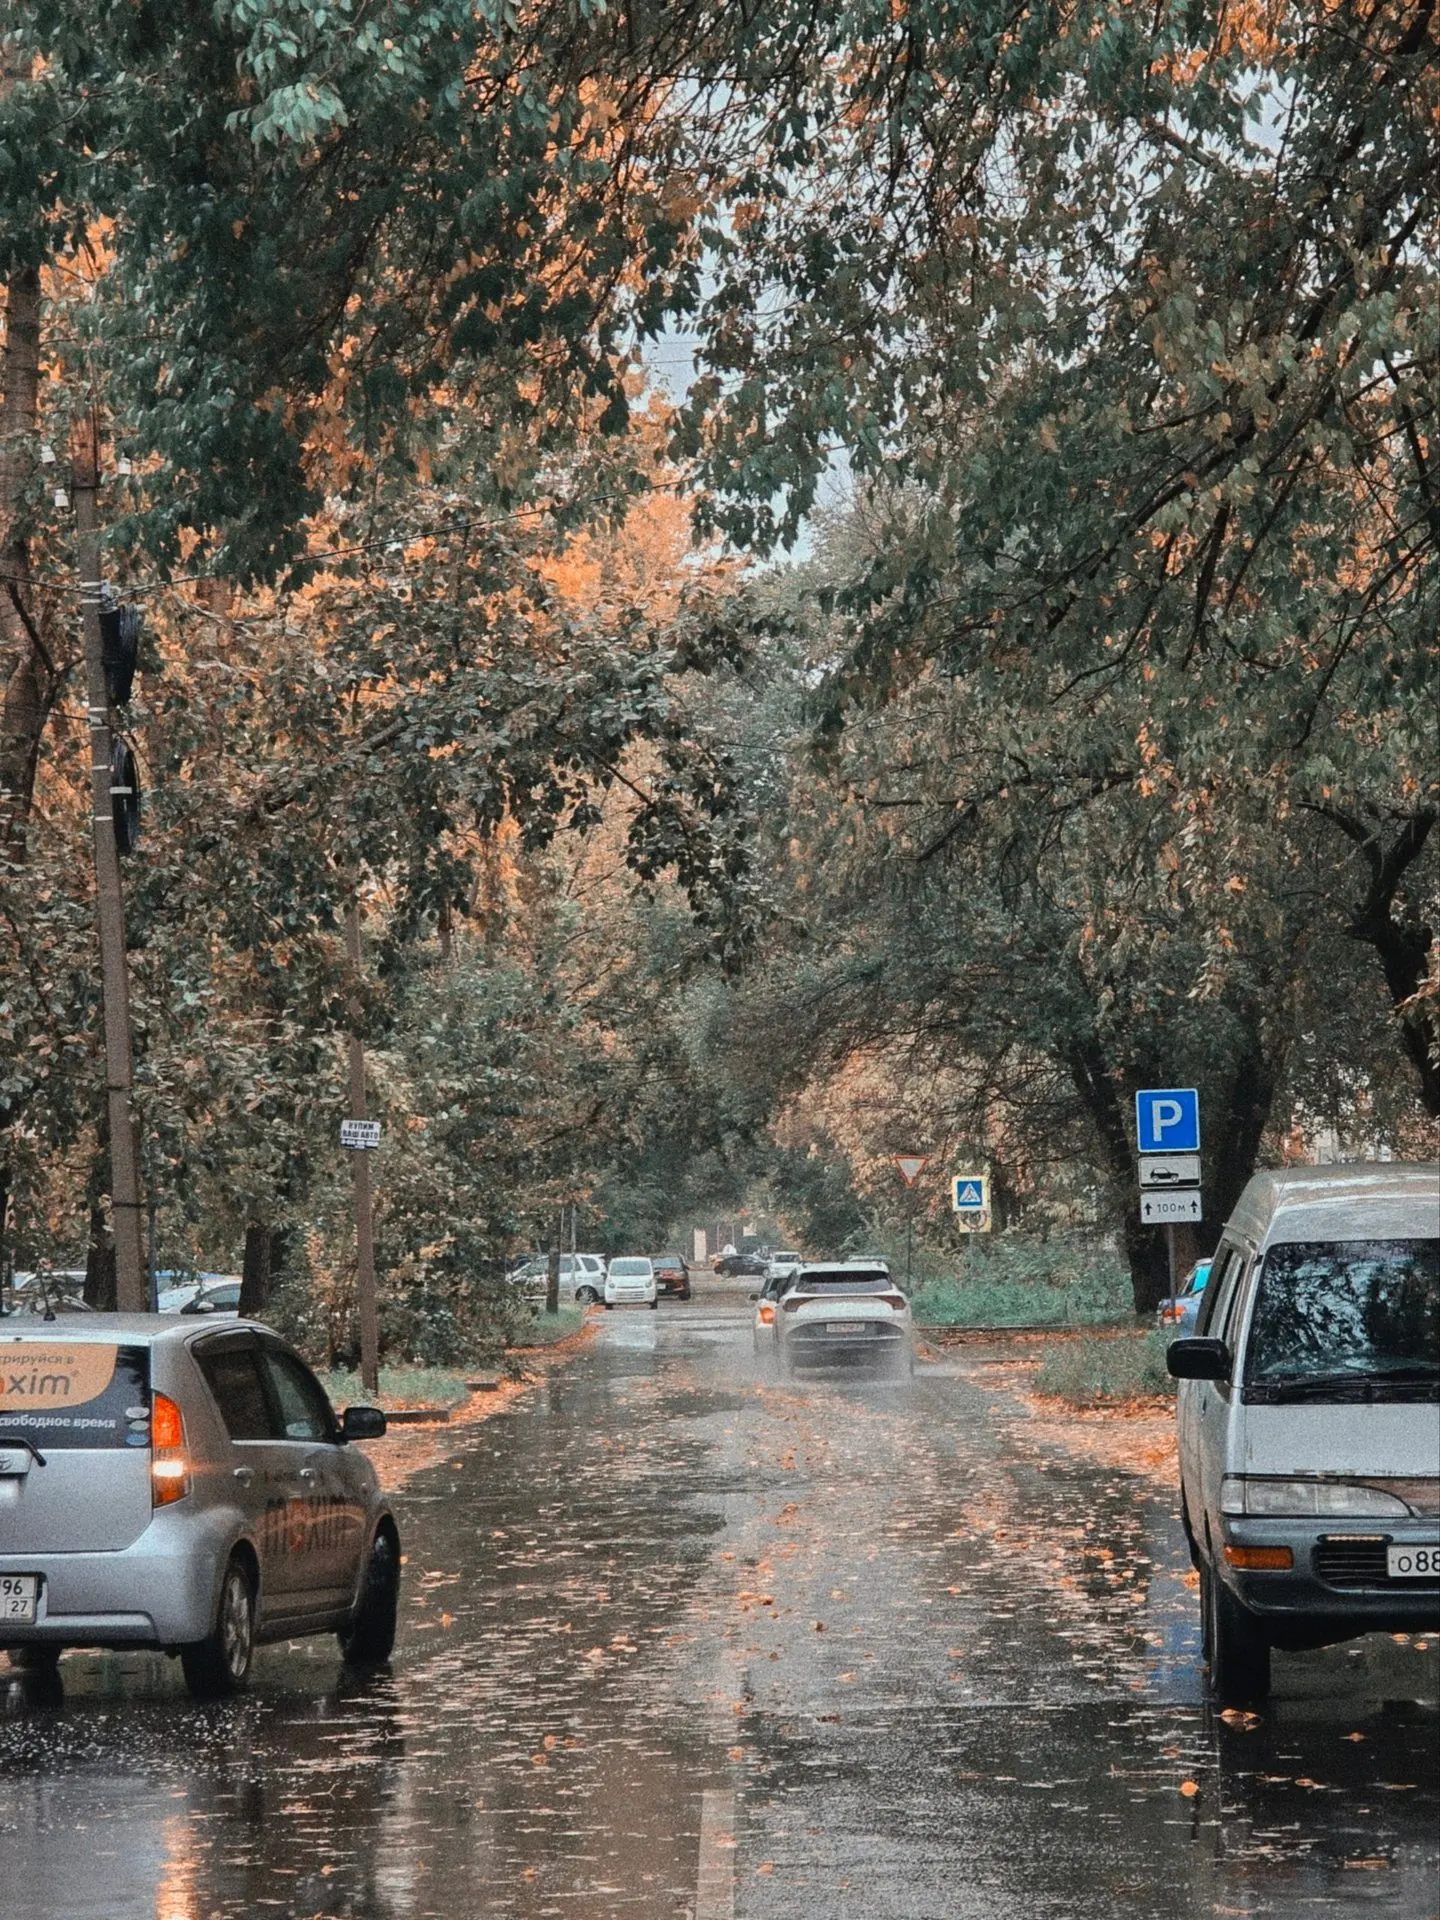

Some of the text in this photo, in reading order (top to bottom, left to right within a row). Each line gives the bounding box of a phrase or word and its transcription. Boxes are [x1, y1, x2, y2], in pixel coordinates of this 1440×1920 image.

[1152, 1100, 1182, 1142] P
[342, 1130, 379, 1140] ВАШ АВТО
[73, 1420, 117, 1430] время
[11, 1600, 28, 1613] 27
